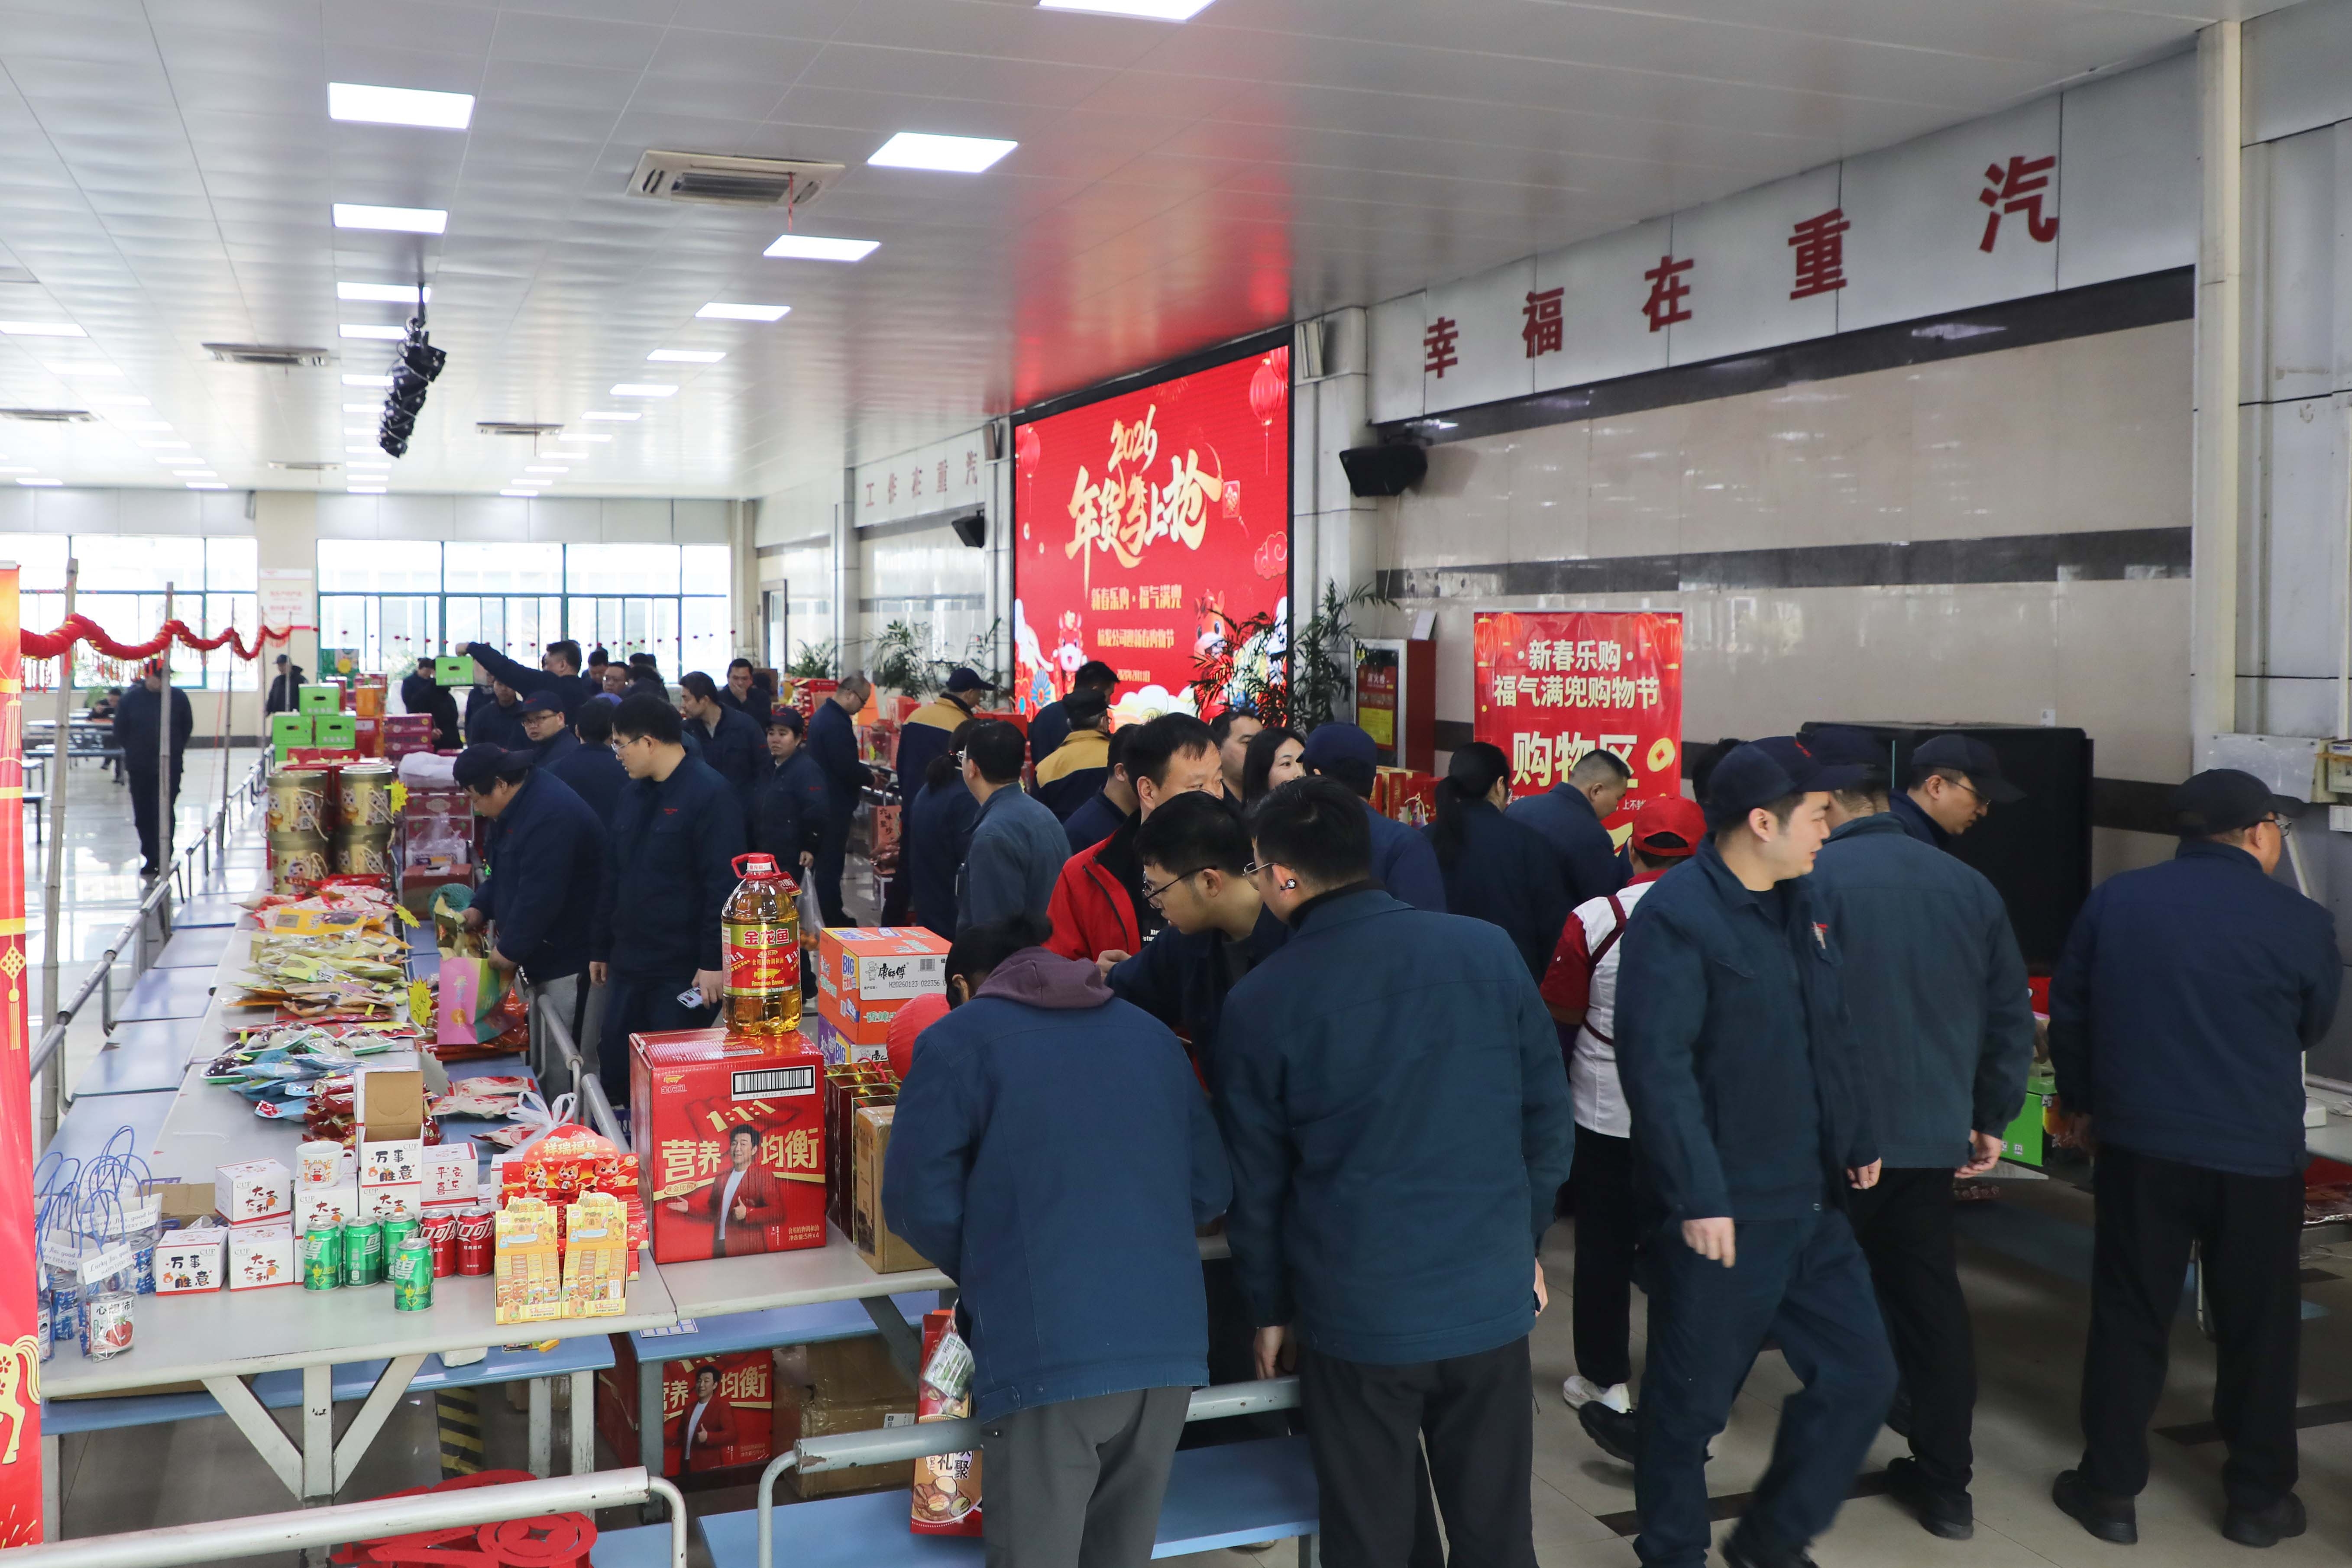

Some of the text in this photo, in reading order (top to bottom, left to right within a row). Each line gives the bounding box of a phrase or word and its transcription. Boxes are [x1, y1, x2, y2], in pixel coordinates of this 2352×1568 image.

[1423, 155, 2058, 379] 幸福在重汽
[1108, 404, 1158, 474] 2026
[1494, 675, 1660, 709] 福气满兜购物节
[744, 928, 790, 945] 金龙鱼
[843, 955, 854, 975] BIG
[706, 1100, 776, 1132] 1:1:1
[375, 1149, 404, 1163] 万事
[543, 1139, 598, 1156] 祥瑞福马
[661, 1139, 721, 1183] 营养
[761, 1127, 819, 1169] 均衡
[171, 1254, 201, 1269] 万事
[720, 1364, 767, 1398] 均衡
